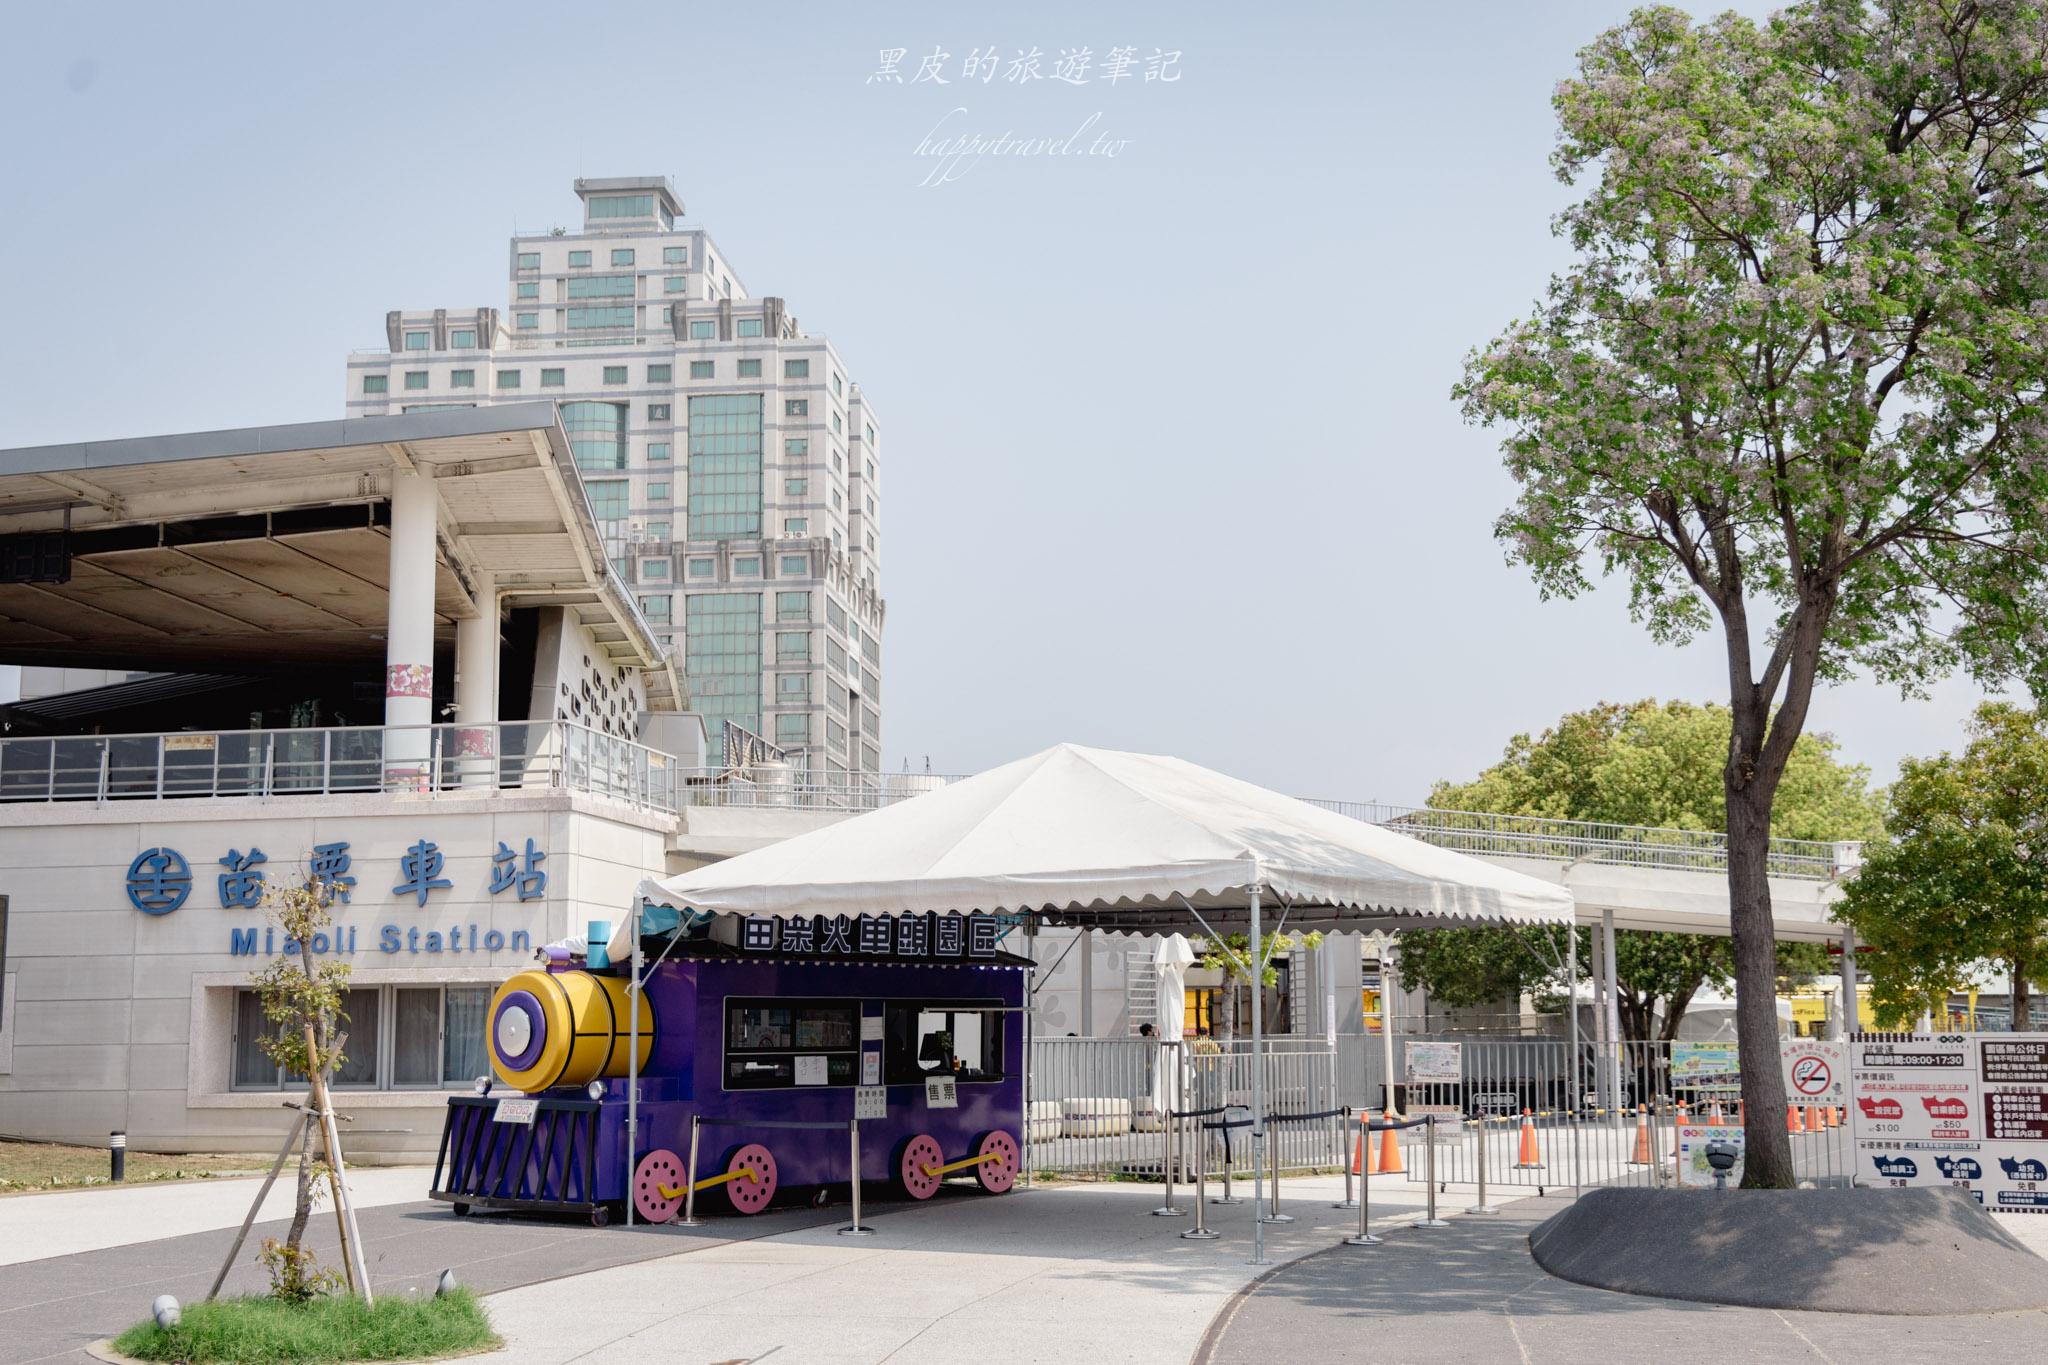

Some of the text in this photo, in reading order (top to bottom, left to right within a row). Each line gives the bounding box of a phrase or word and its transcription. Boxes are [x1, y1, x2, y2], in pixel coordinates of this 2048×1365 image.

[218, 836, 549, 908] 苗栗車站
[230, 923, 531, 956] Miaoli Station
[1985, 1044, 2046, 1054] 園區無公休日
[928, 1083, 955, 1101] 售票
